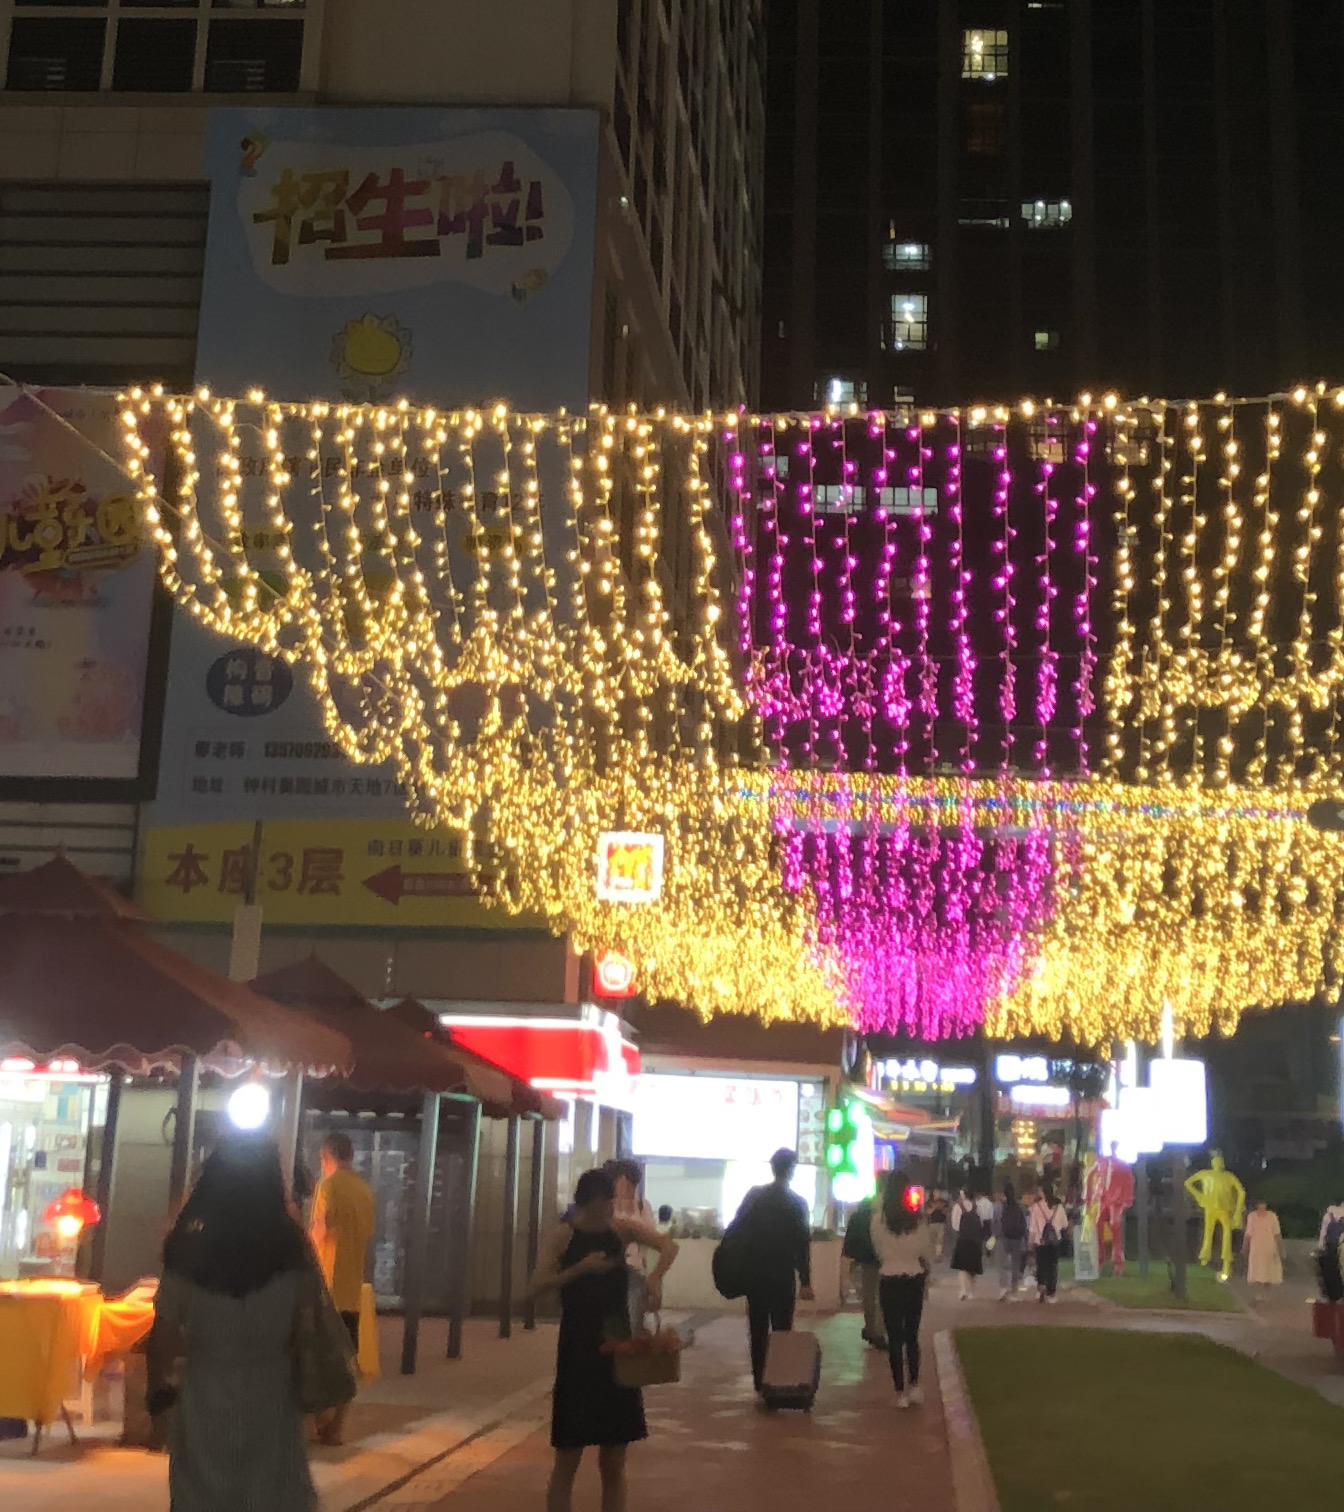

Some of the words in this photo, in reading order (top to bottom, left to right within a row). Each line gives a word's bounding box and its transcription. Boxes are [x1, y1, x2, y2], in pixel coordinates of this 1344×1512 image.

[253, 161, 545, 265] 招生啦!
[164, 843, 347, 896] 本座3层
